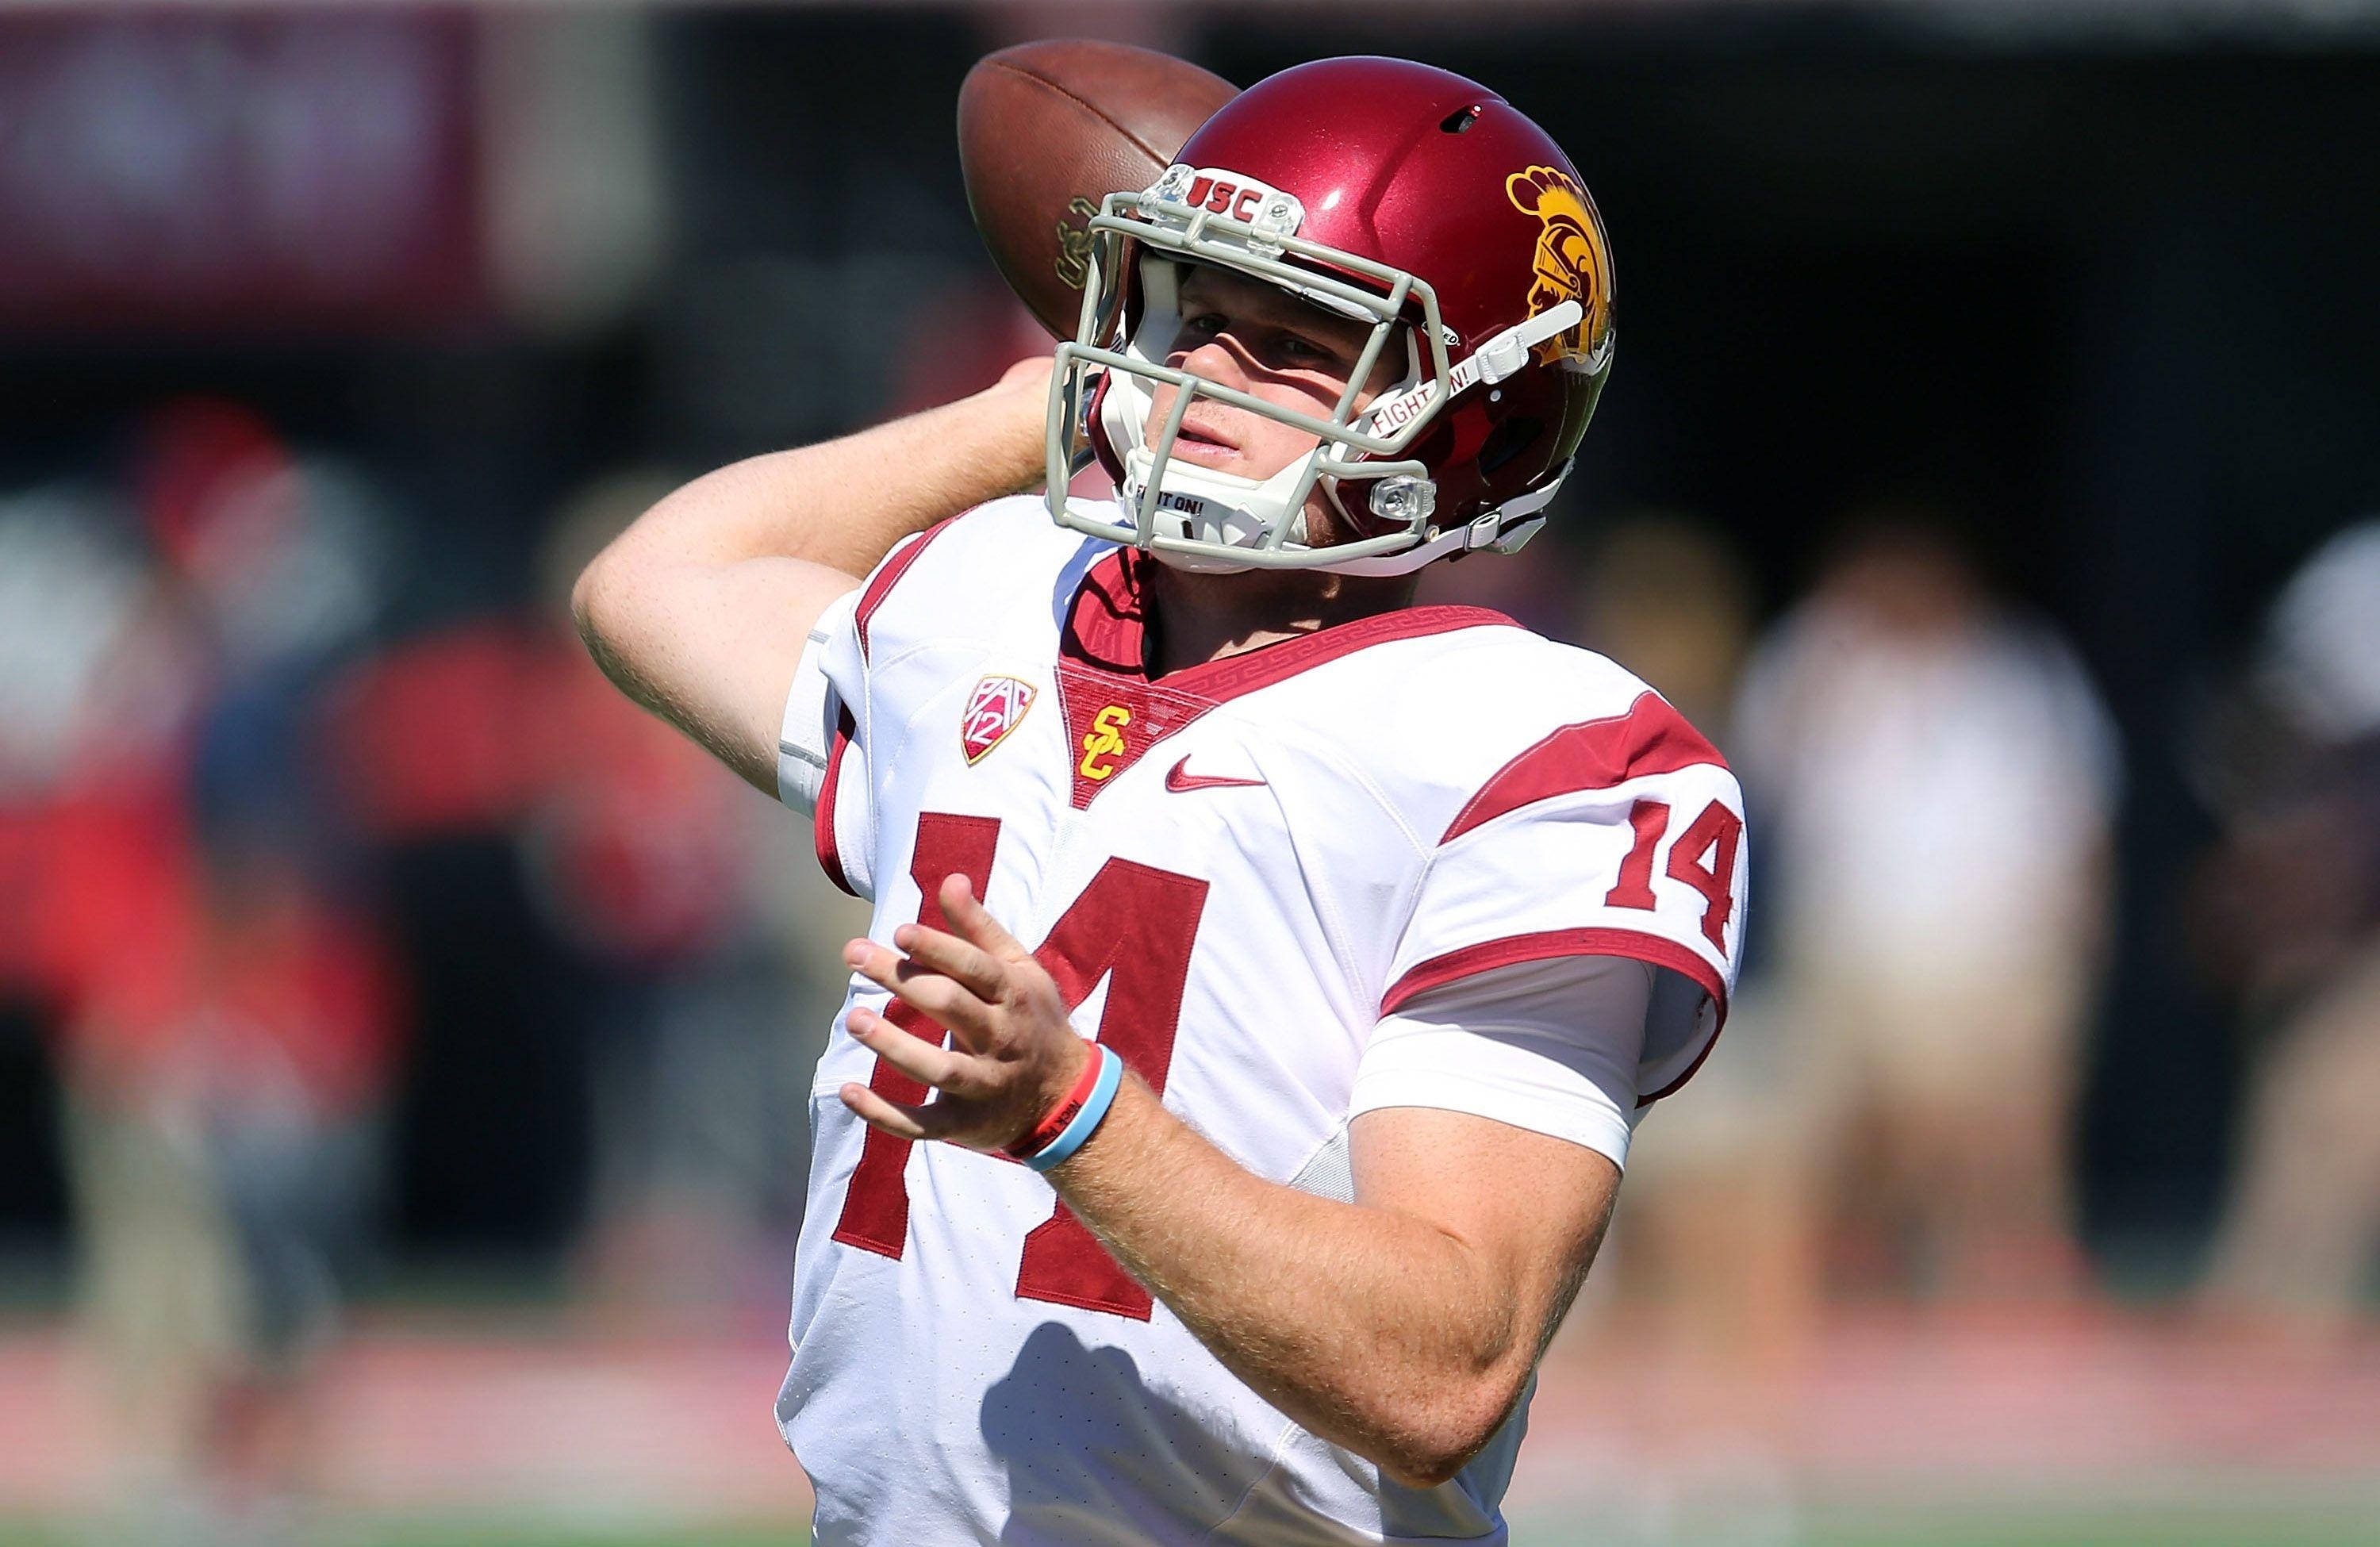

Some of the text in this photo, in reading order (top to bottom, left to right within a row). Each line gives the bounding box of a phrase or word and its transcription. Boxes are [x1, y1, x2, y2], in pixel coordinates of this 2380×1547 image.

[1187, 175, 1263, 223] USC
[1372, 367, 1469, 433] FIGHT N!
[1136, 484, 1203, 516] FIT ON!
[965, 677, 1034, 732] PAC
[965, 709, 1004, 746] 12
[1079, 704, 1131, 781] SC
[1603, 798, 1742, 962] 14
[831, 811, 1211, 1322] 14
